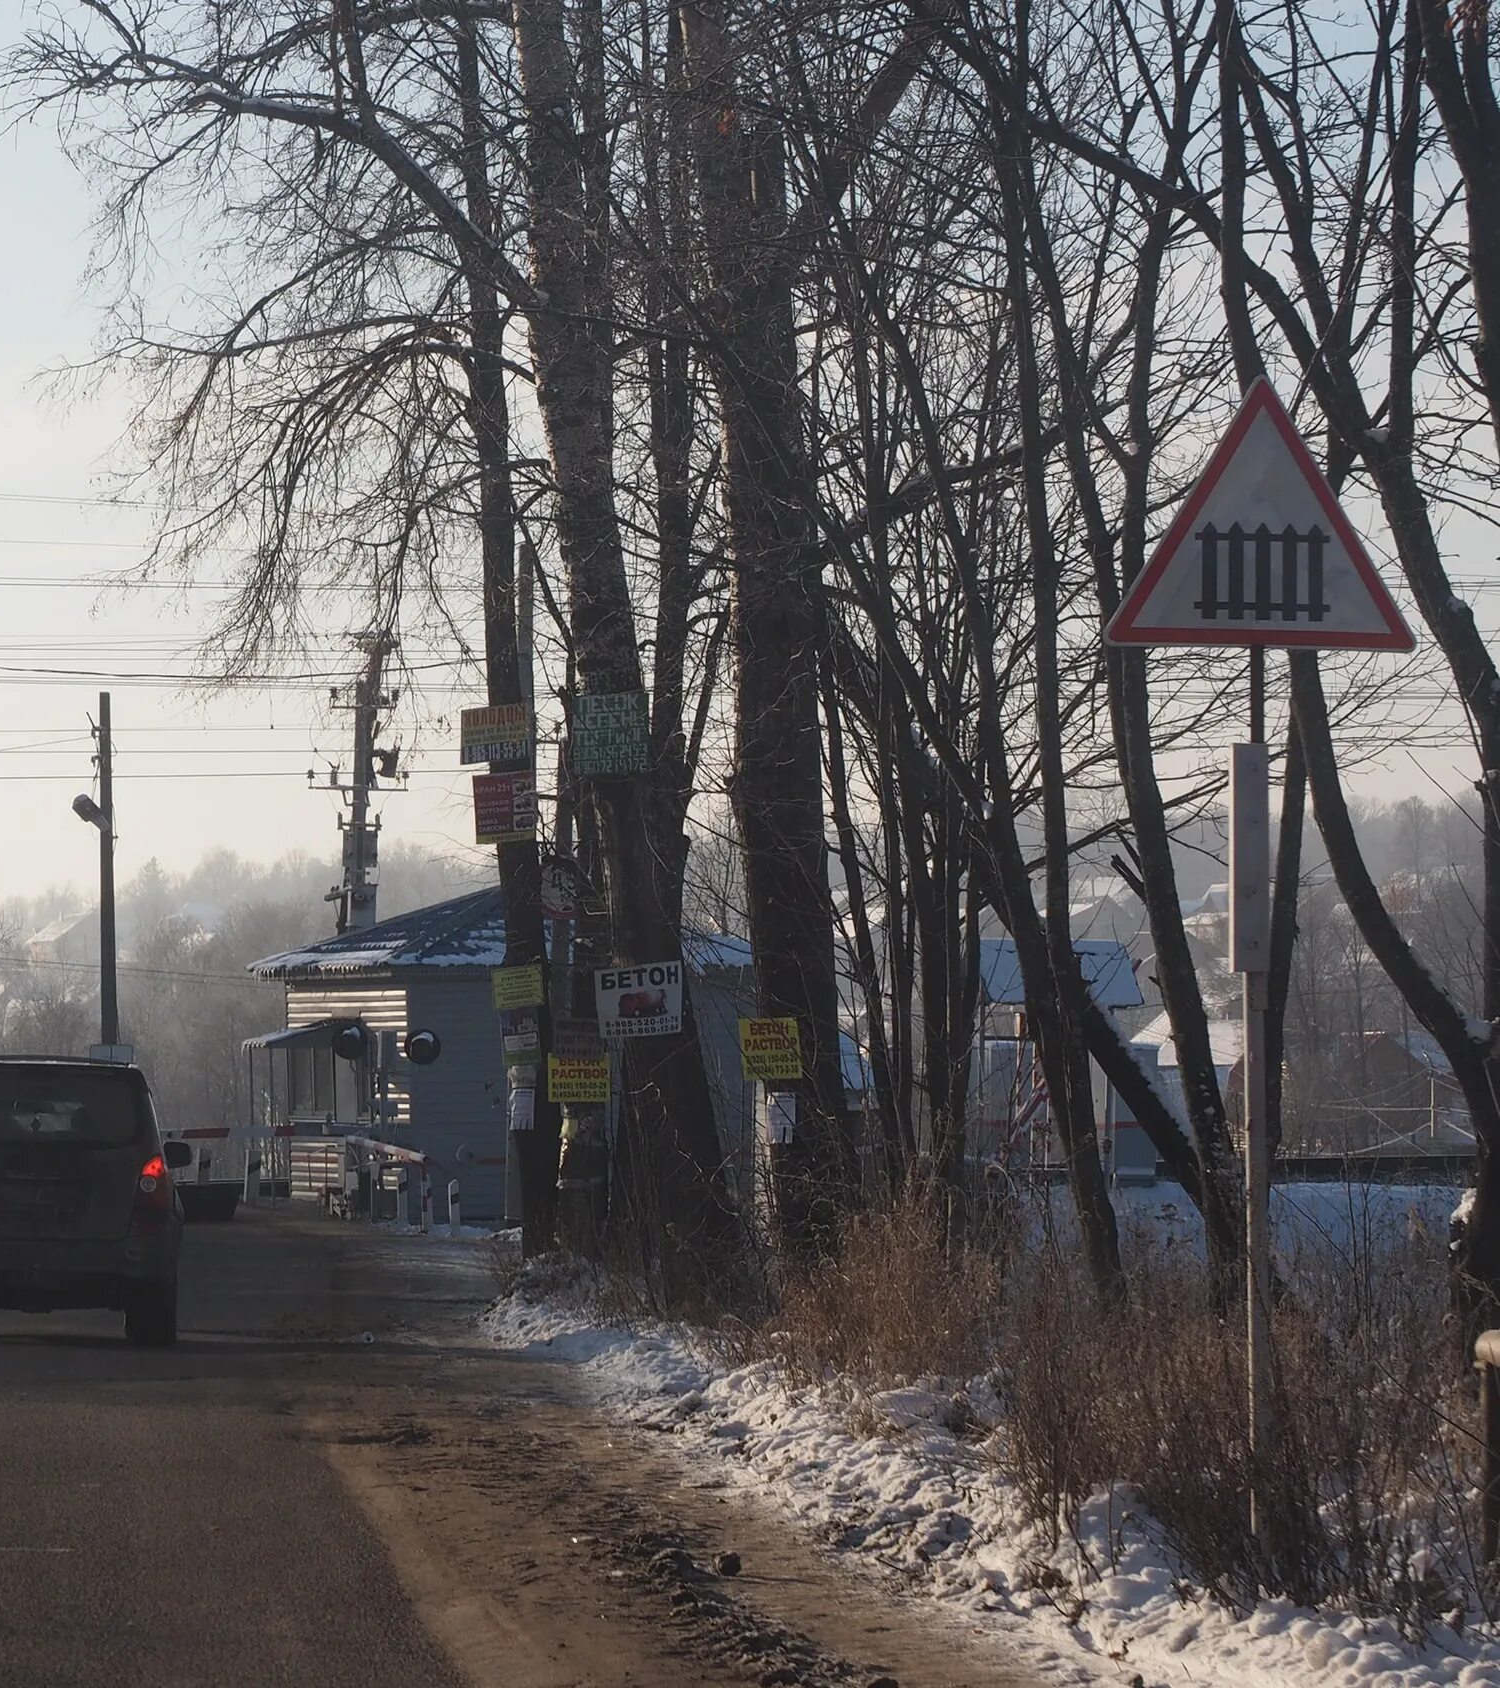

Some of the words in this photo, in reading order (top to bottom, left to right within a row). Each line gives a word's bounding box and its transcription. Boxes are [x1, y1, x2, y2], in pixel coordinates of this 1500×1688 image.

[579, 694, 639, 713] ПЕСОК
[601, 965, 678, 990] БЕТОН
[749, 1021, 789, 1035] БЕТОН
[744, 1037, 797, 1051] РАСТВОР
[551, 1068, 608, 1079] РАСТВОР
